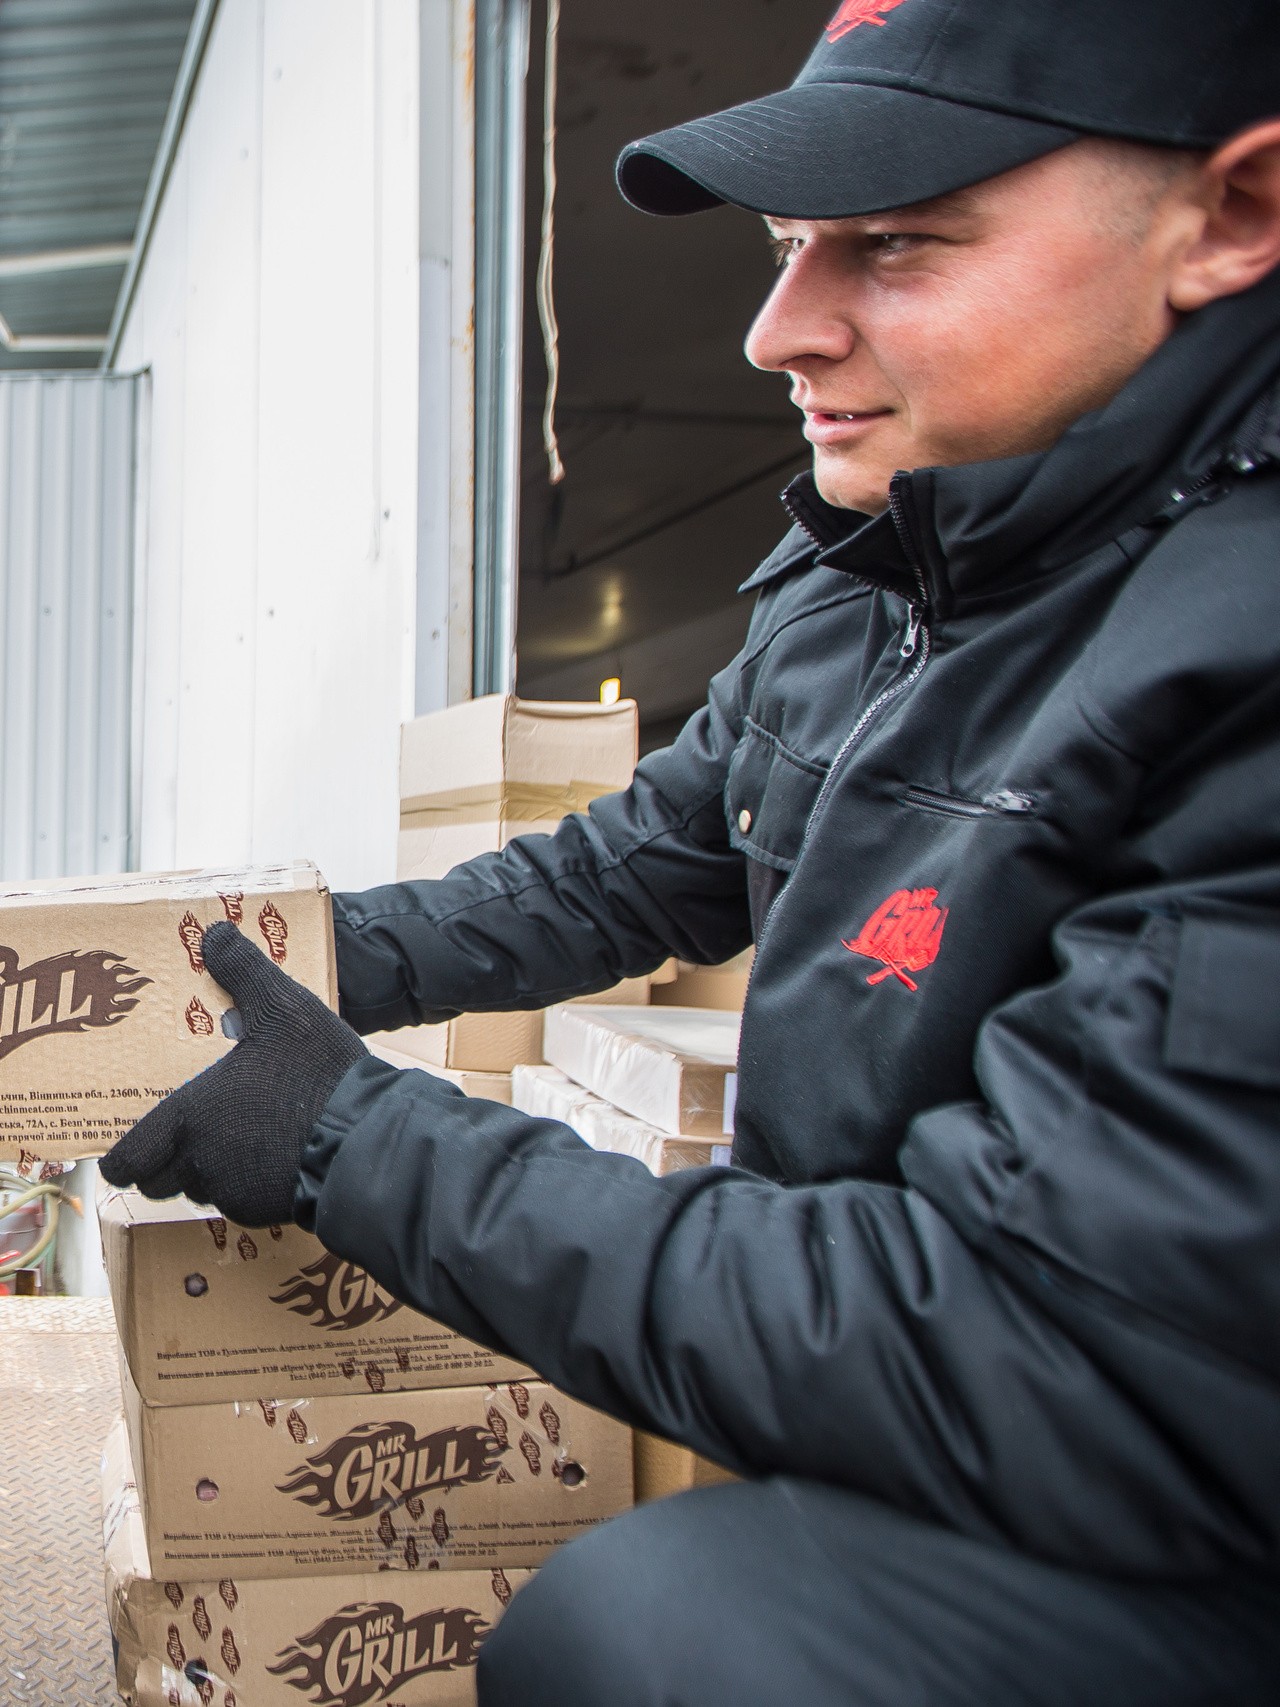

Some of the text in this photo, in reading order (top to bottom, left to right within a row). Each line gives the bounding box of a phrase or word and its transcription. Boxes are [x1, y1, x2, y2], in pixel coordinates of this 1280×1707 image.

[184, 926, 204, 964] GRILL
[263, 916, 284, 955] GRILL
[29, 1090, 83, 1101] Вінницька
[84, 1089, 109, 1101] обл.,
[110, 1088, 142, 1099] 23600,
[144, 1087, 177, 1098] Украї
[114, 1117, 140, 1127] Васи
[7, 1131, 45, 1142] гарячої
[73, 1131, 80, 1140] 0
[82, 1131, 99, 1140] 800
[101, 1130, 113, 1139] 50
[376, 1433, 406, 1458] MR
[334, 1441, 470, 1510] GRILL
[366, 1614, 394, 1640] MR
[324, 1621, 457, 1696] GRILL
